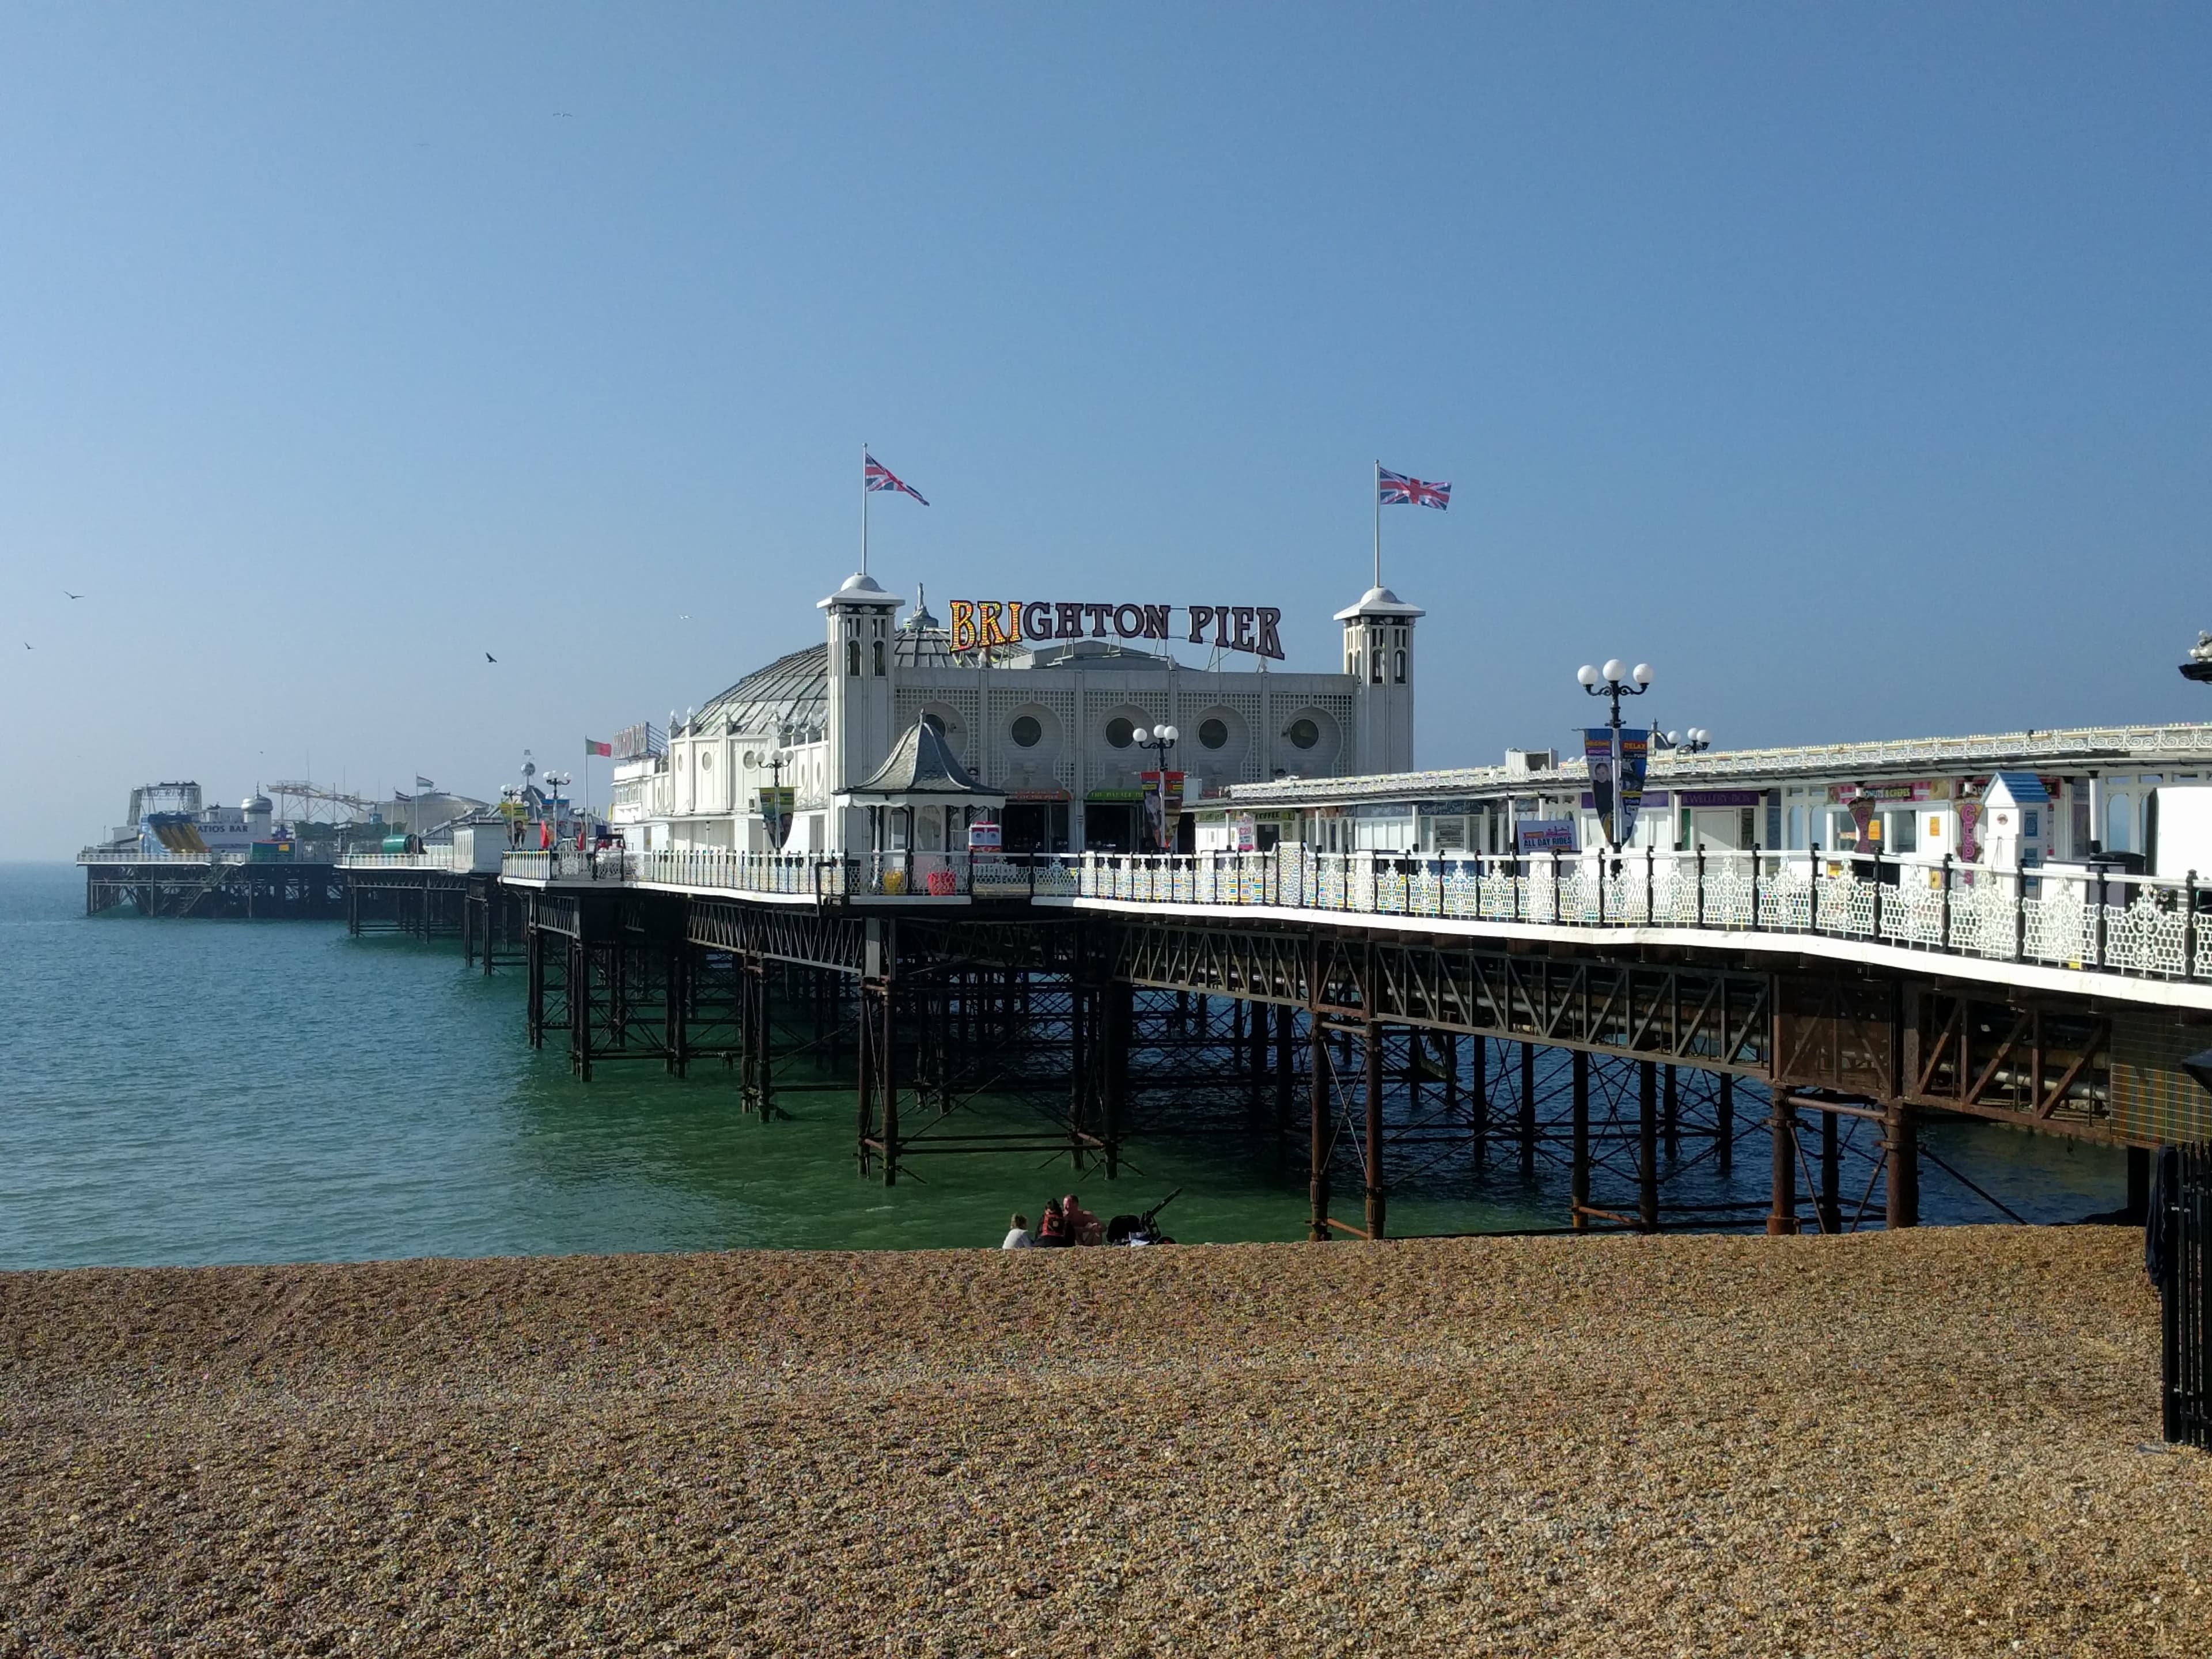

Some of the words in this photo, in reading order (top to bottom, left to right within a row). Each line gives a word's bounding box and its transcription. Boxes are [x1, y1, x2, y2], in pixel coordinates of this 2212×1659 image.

[950, 600, 1171, 653] BRIGHTON
[1188, 606, 1285, 660] PIER
[1683, 795, 1728, 804] JEWELLERY
[1732, 794, 1751, 802] BOX
[194, 825, 225, 833] ATIOS
[229, 825, 248, 833] BAR
[1552, 837, 1572, 845] RIDES
